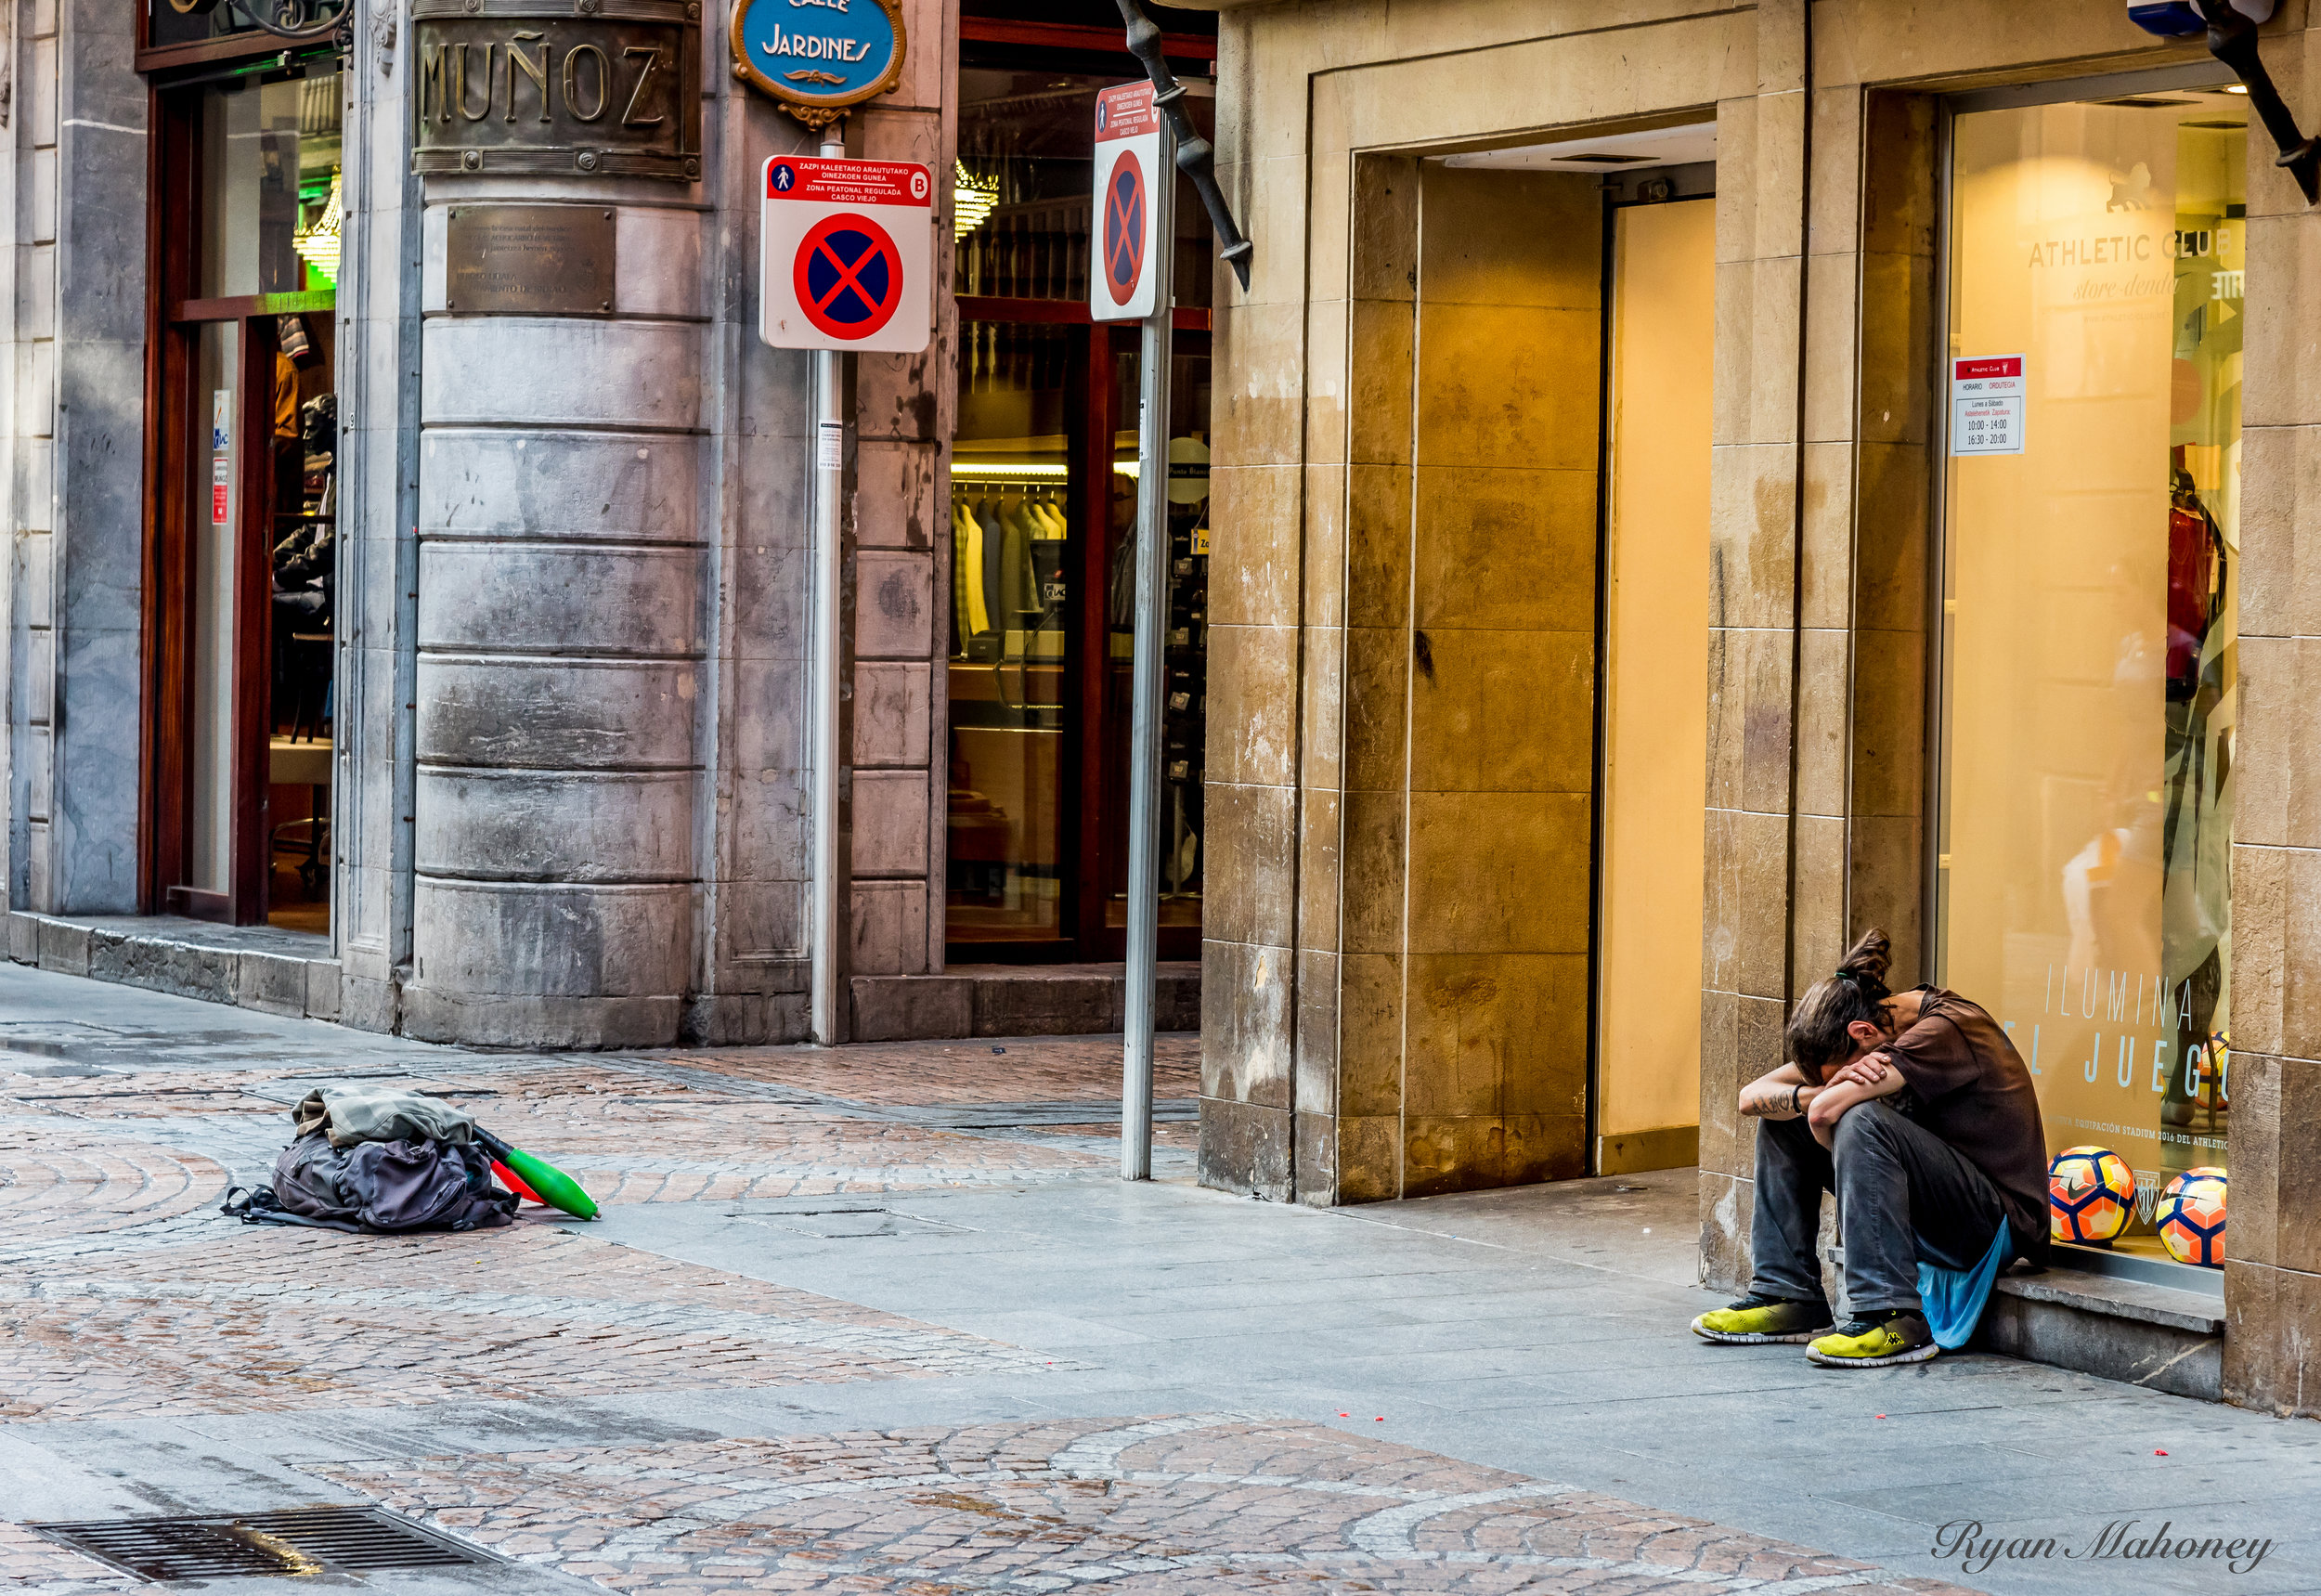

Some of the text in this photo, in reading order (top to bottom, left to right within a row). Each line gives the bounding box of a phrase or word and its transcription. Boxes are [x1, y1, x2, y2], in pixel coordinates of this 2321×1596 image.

[761, 23, 871, 61] JARDINES
[421, 30, 665, 124] MUÑOZ
[821, 164, 862, 173] KALEETAKO
[863, 166, 908, 175] ARAUTUTAKO
[826, 186, 862, 194] PEATONAL
[864, 188, 901, 196] REGULADA
[914, 178, 925, 192] B
[2028, 228, 2231, 268] ATHLETIC CLUB
[1989, 381, 2016, 389] ORDUTEGIA
[1968, 420, 1984, 430] 10:00
[1990, 419, 2006, 429] 14:00
[1968, 435, 1984, 445] 16:30
[1990, 434, 2006, 444] 20:00
[2045, 963, 2192, 1032] ILUMINA
[2075, 1118, 2120, 1134] EQUIPACIÓN
[2122, 1126, 2156, 1140] STADIUM
[2158, 1131, 2174, 1142] 2016
[2176, 1134, 2191, 1145] DEL
[2193, 1136, 2228, 1150] ATHLETIC
